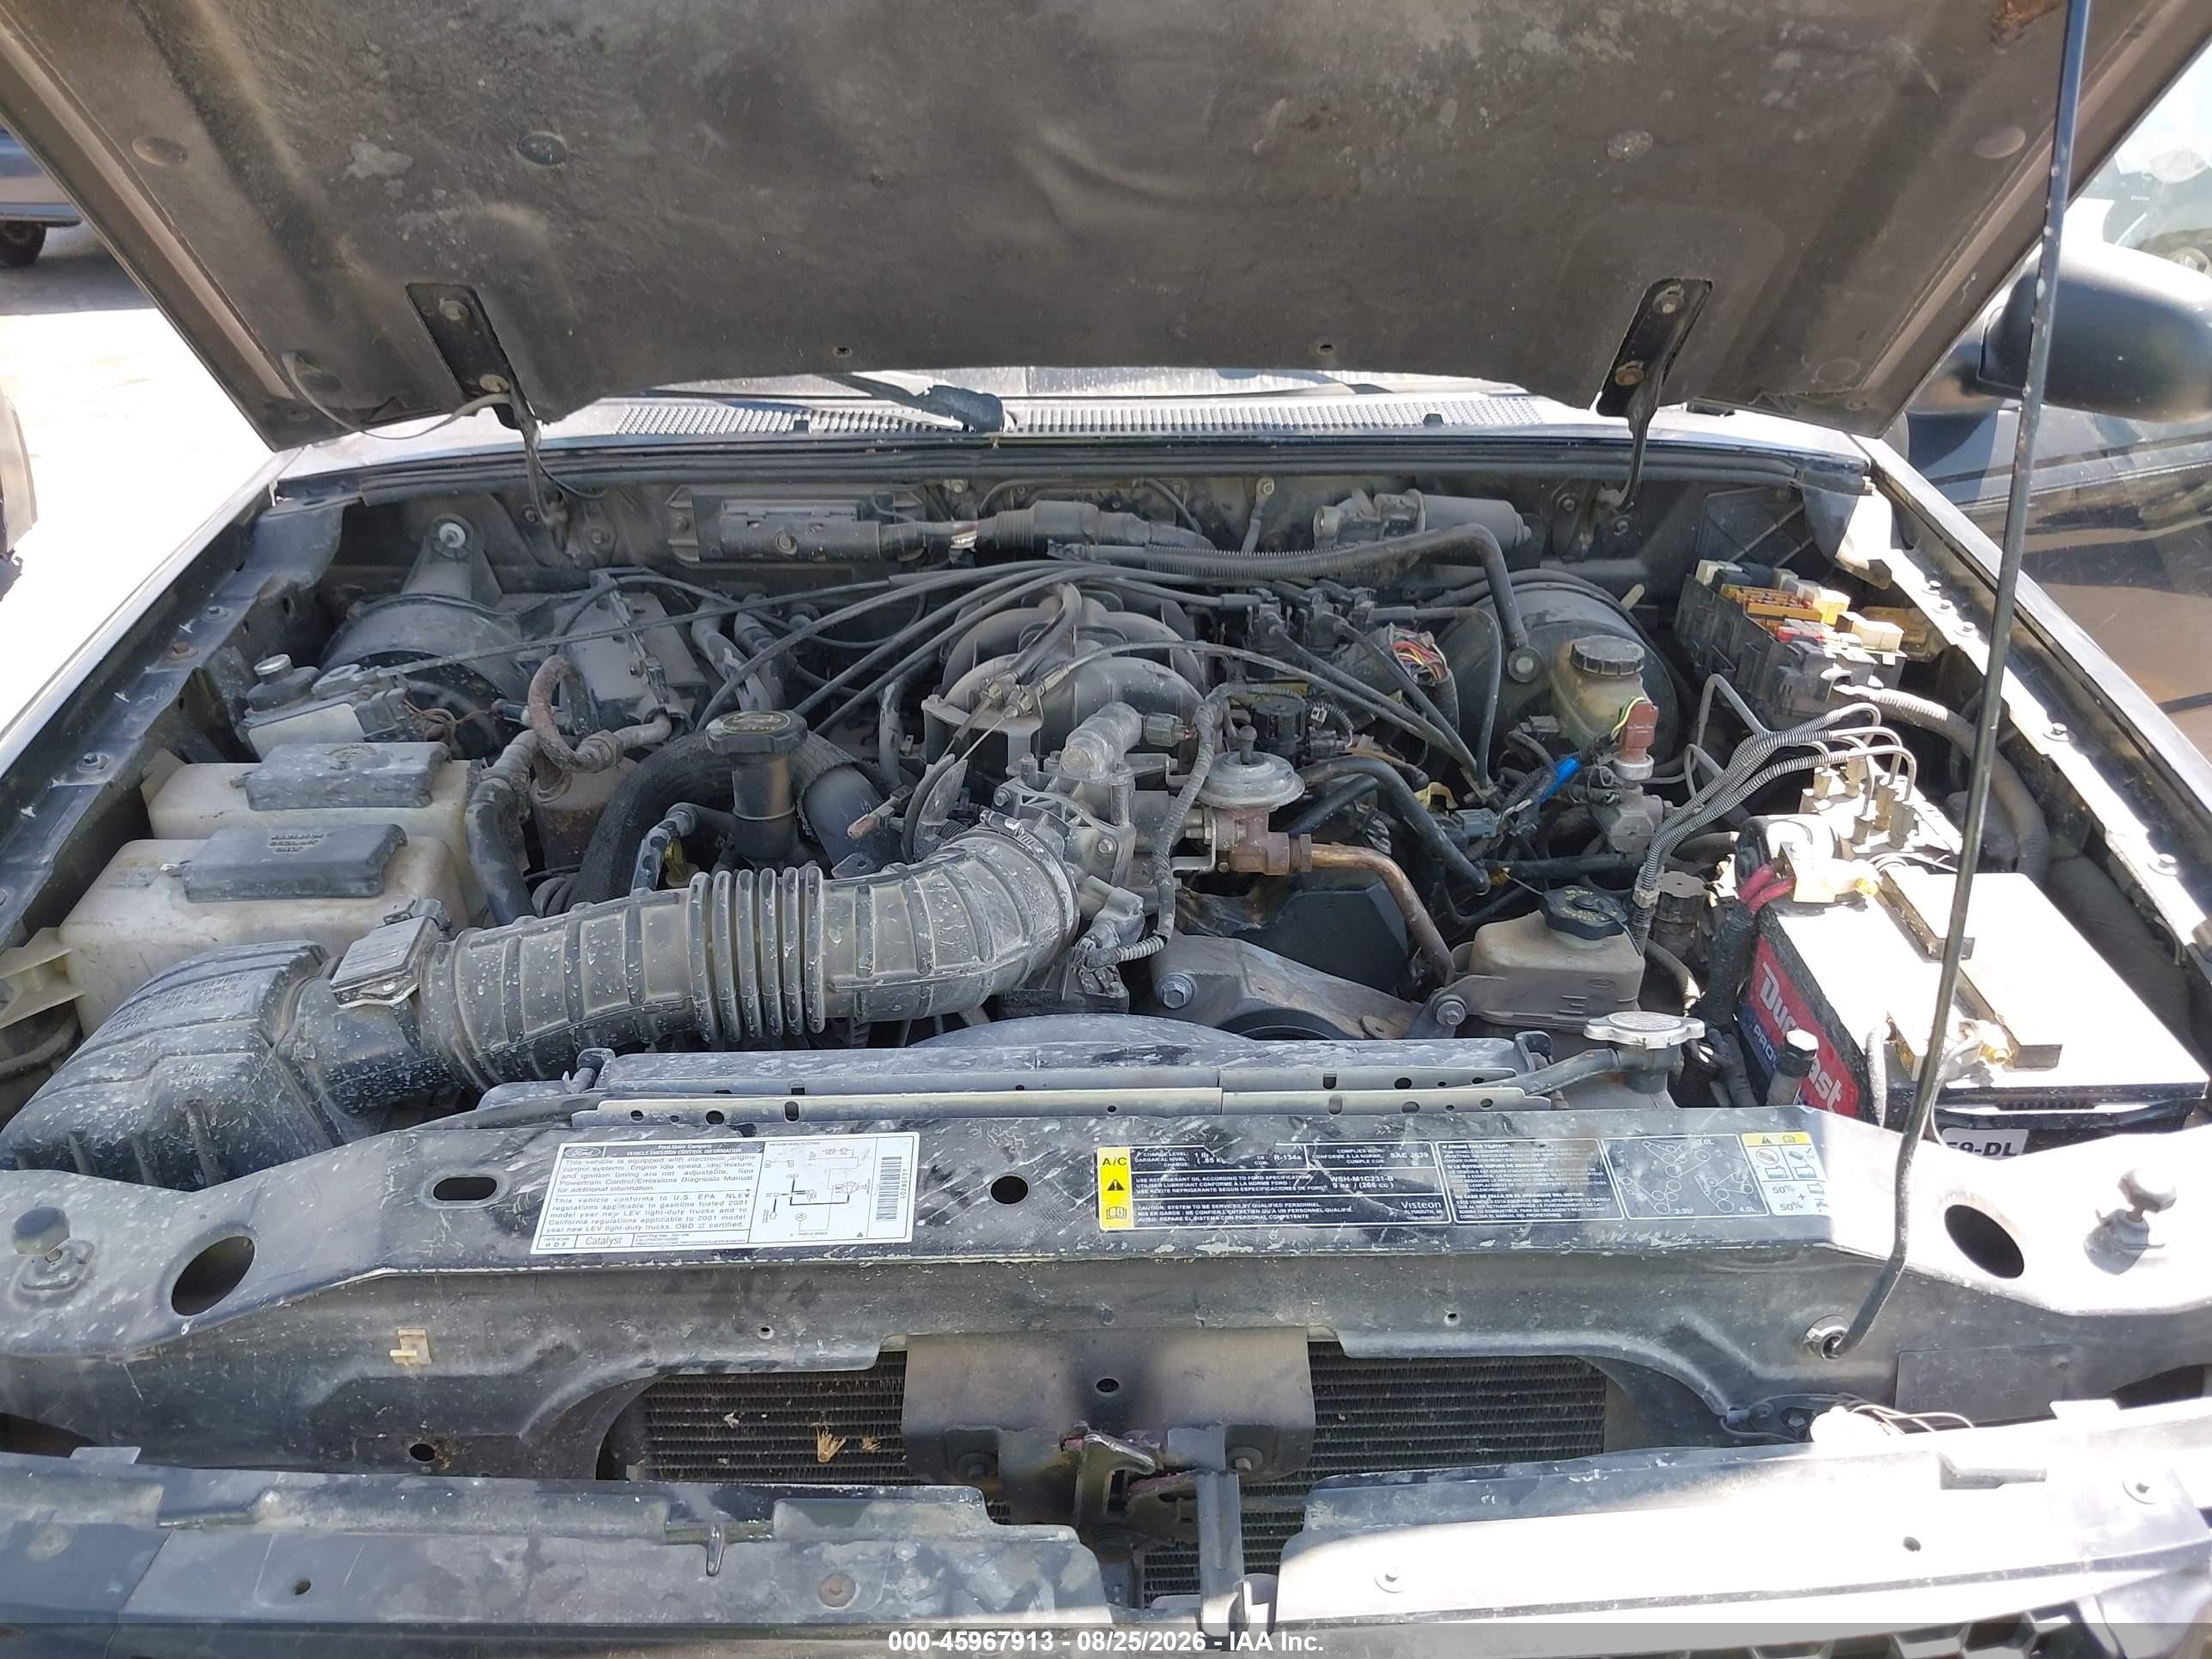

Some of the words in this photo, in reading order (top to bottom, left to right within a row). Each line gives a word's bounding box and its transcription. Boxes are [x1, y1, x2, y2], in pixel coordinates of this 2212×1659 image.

[1761, 961, 1842, 1113] Durast
[628, 1156, 665, 1164] equipped
[1102, 1157, 1127, 1166] A/C
[1771, 1185, 1796, 1194] 50%
[1779, 1201, 1803, 1211] 50%
[585, 1237, 623, 1248] Catalyst
